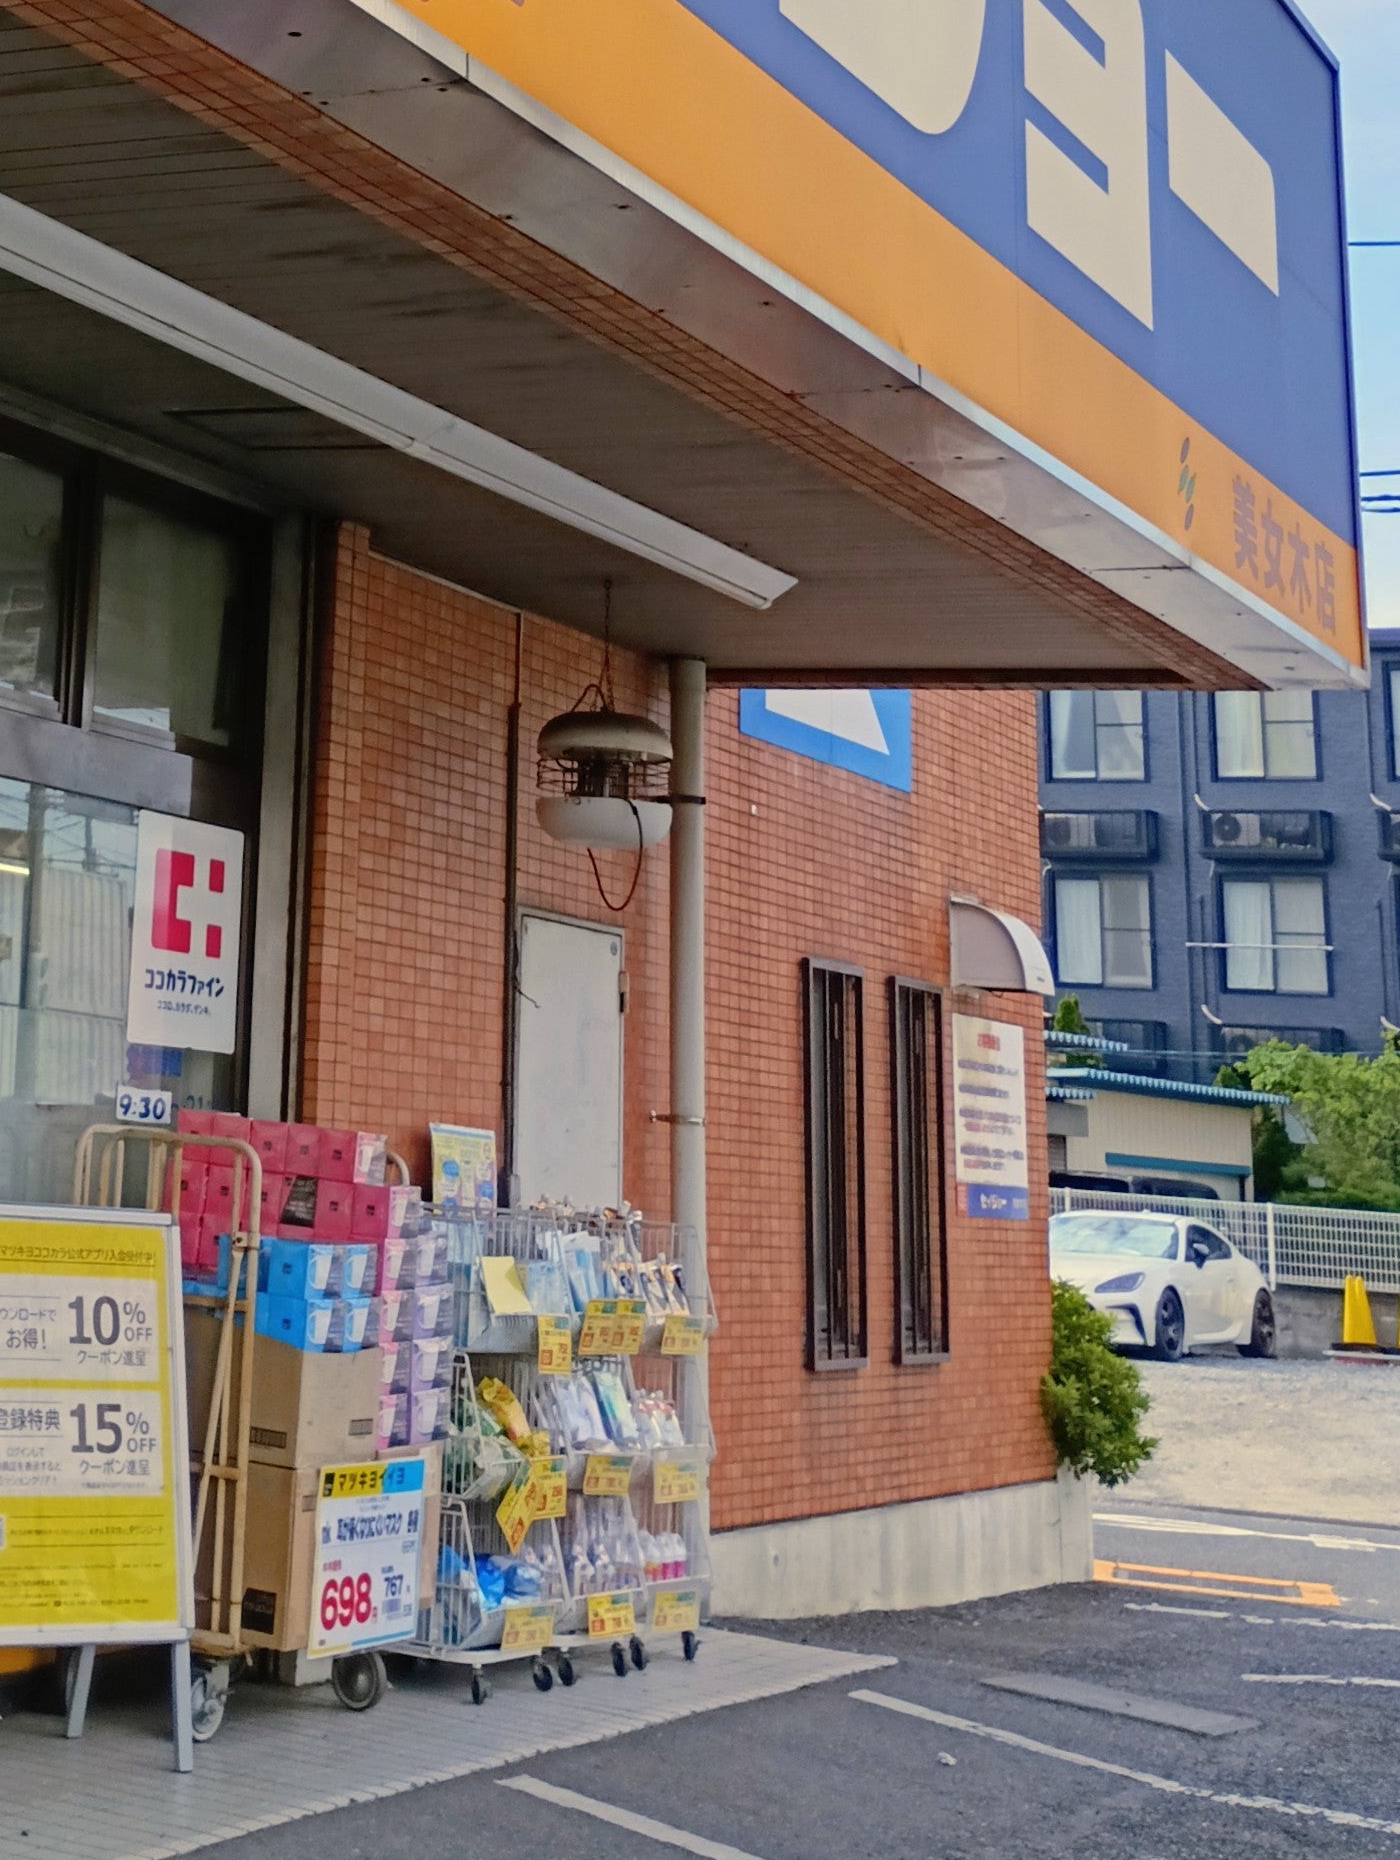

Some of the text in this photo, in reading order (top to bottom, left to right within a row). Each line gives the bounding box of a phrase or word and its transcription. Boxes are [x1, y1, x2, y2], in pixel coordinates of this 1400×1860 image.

[1232, 474, 1337, 636] 美女木店
[144, 968, 225, 998] ココカラファイン
[119, 1093, 167, 1121] 9:30
[5, 1328, 47, 1350] お得!
[123, 1326, 153, 1342] OFF
[77, 1350, 147, 1367] クーポン進呈
[126, 1437, 157, 1453] OFF
[79, 1458, 151, 1476] クーポン進呈
[383, 1574, 404, 1597] 767
[320, 1572, 372, 1631] 698
